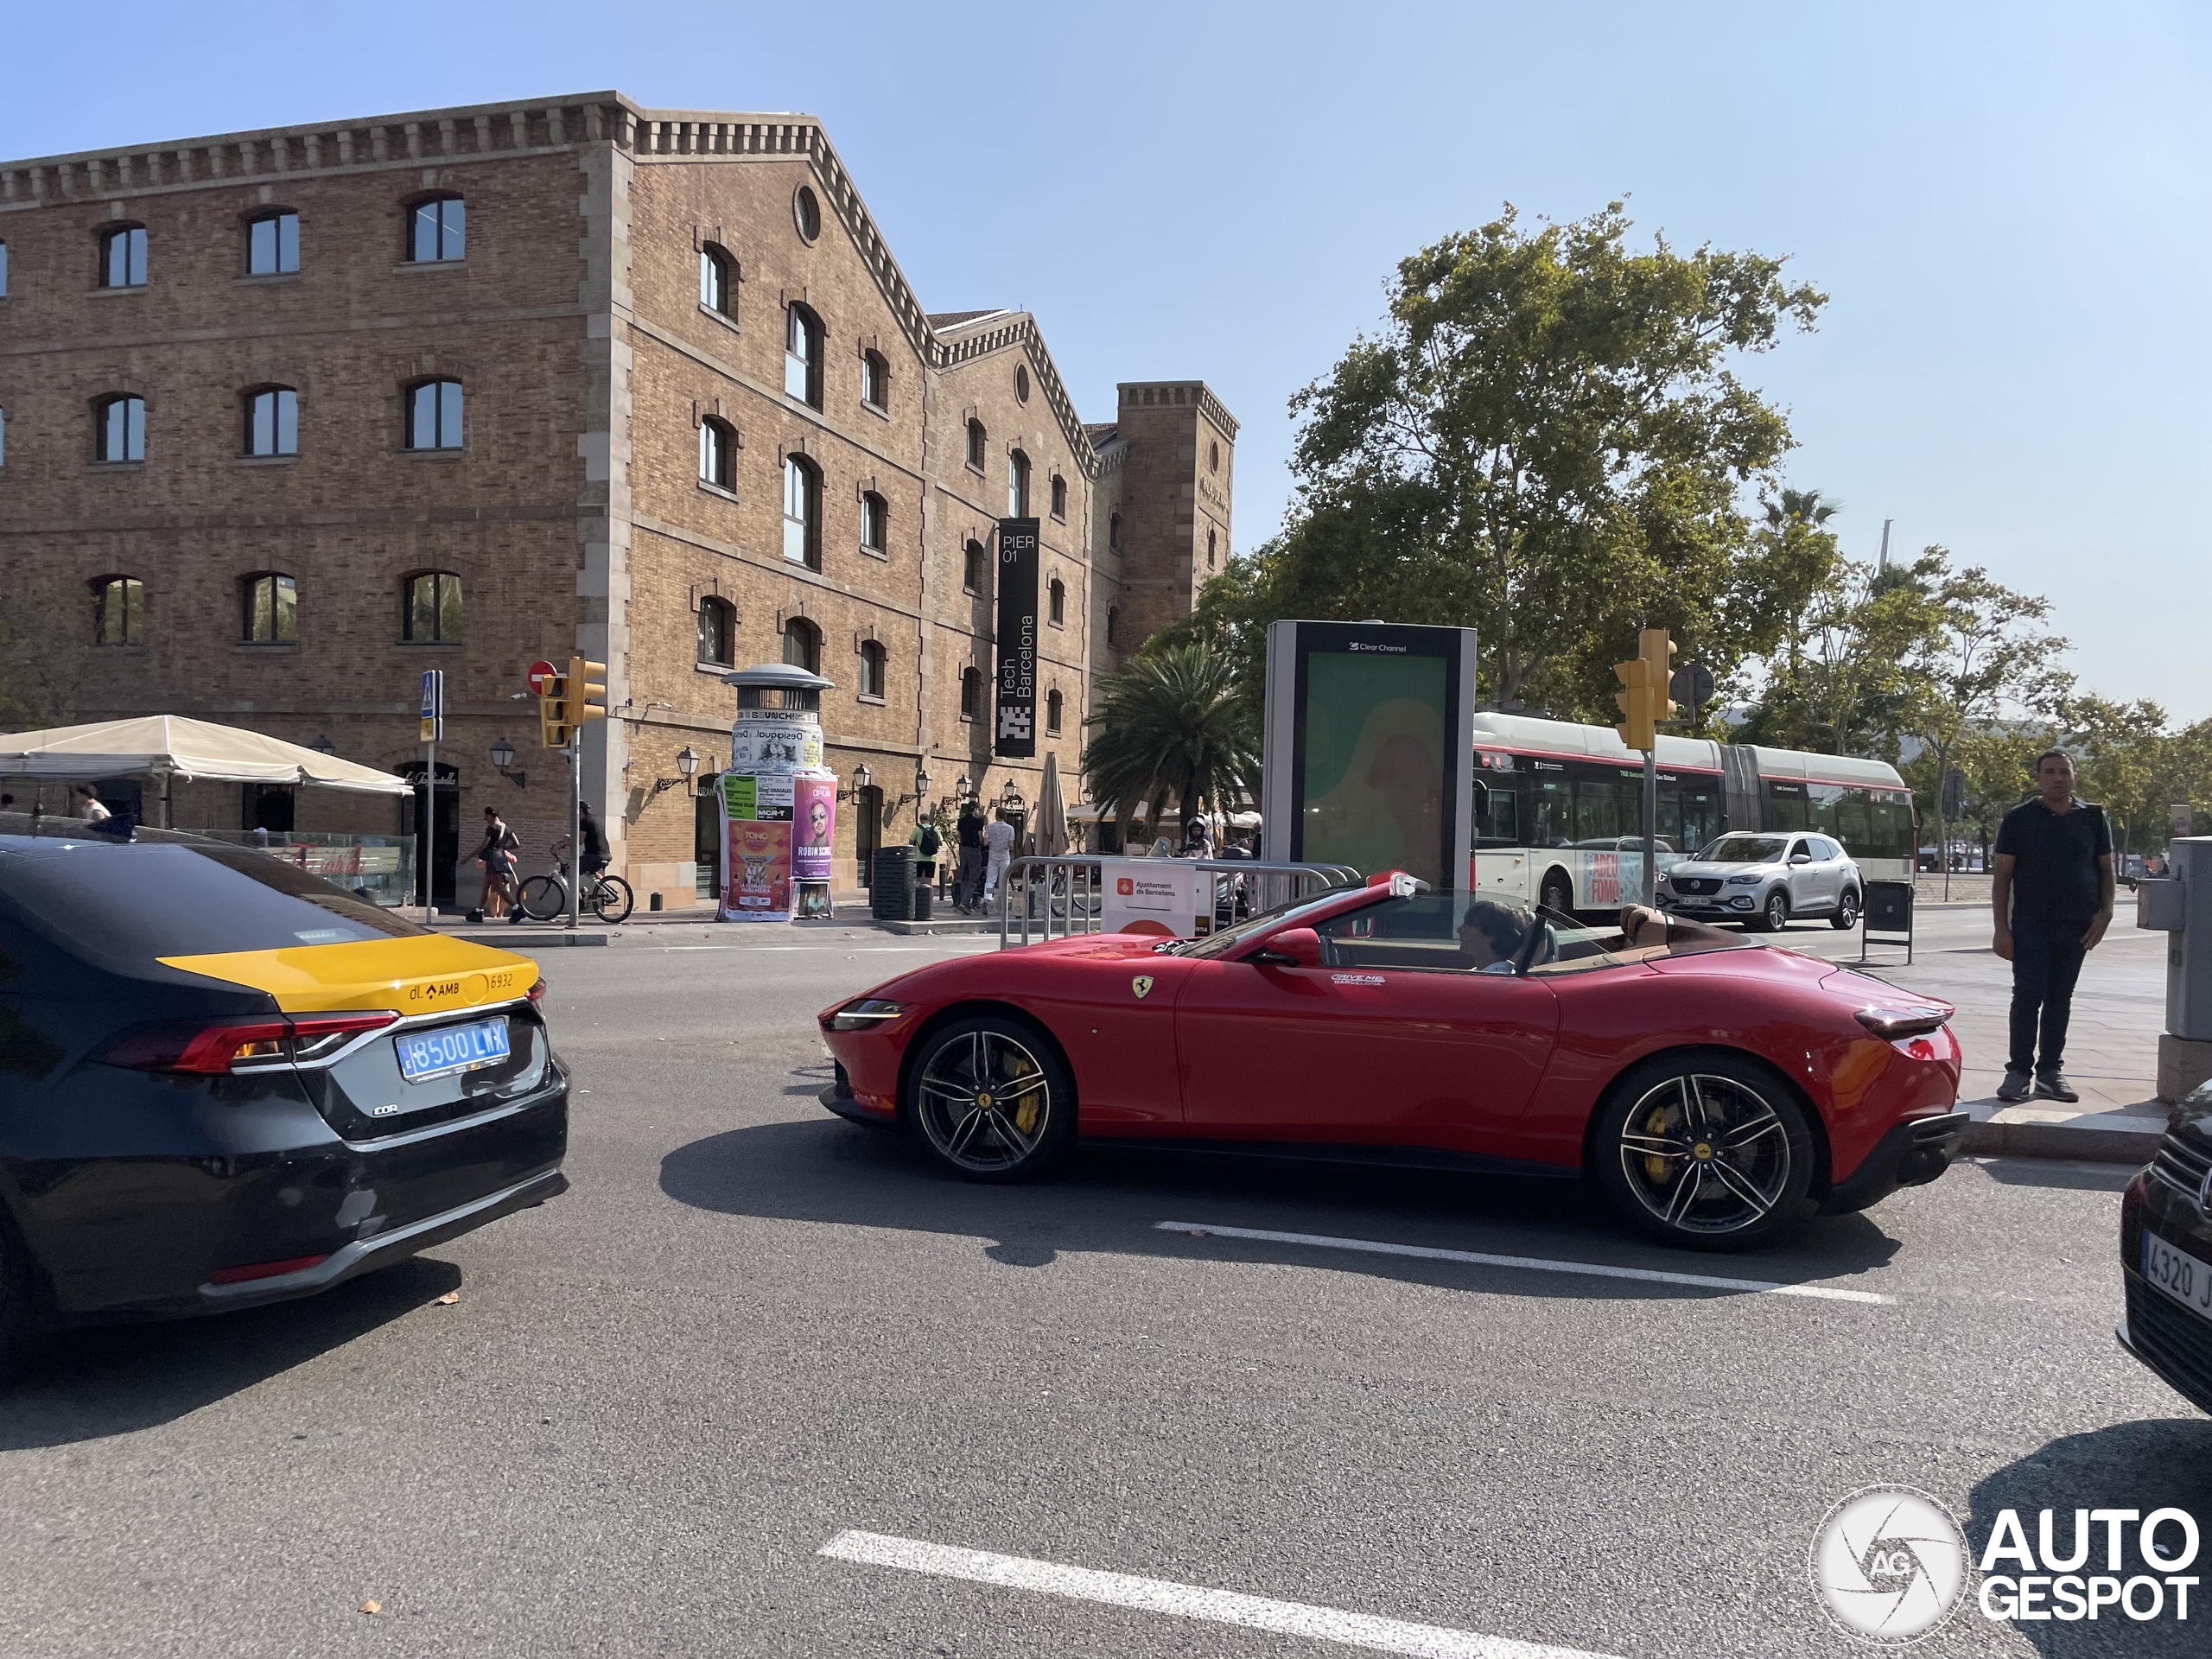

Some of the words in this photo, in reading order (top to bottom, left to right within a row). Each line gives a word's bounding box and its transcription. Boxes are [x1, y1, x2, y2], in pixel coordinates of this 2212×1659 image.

[1003, 536, 1034, 549] PIER
[1002, 550, 1017, 563] 01
[1017, 615, 1033, 698] Barcelona
[1378, 644, 1407, 652] Channel
[1001, 658, 1016, 699] Tech
[798, 846, 818, 856] ROBIN
[1592, 853, 1618, 878] ADEU
[1145, 888, 1176, 897] Barcelona
[1592, 879, 1620, 904] FOMO
[438, 982, 460, 996] AMB
[491, 974, 512, 988] 6932
[405, 1060, 412, 1070] E
[414, 1033, 469, 1068] 8500
[2151, 1243, 2193, 1297] 4320
